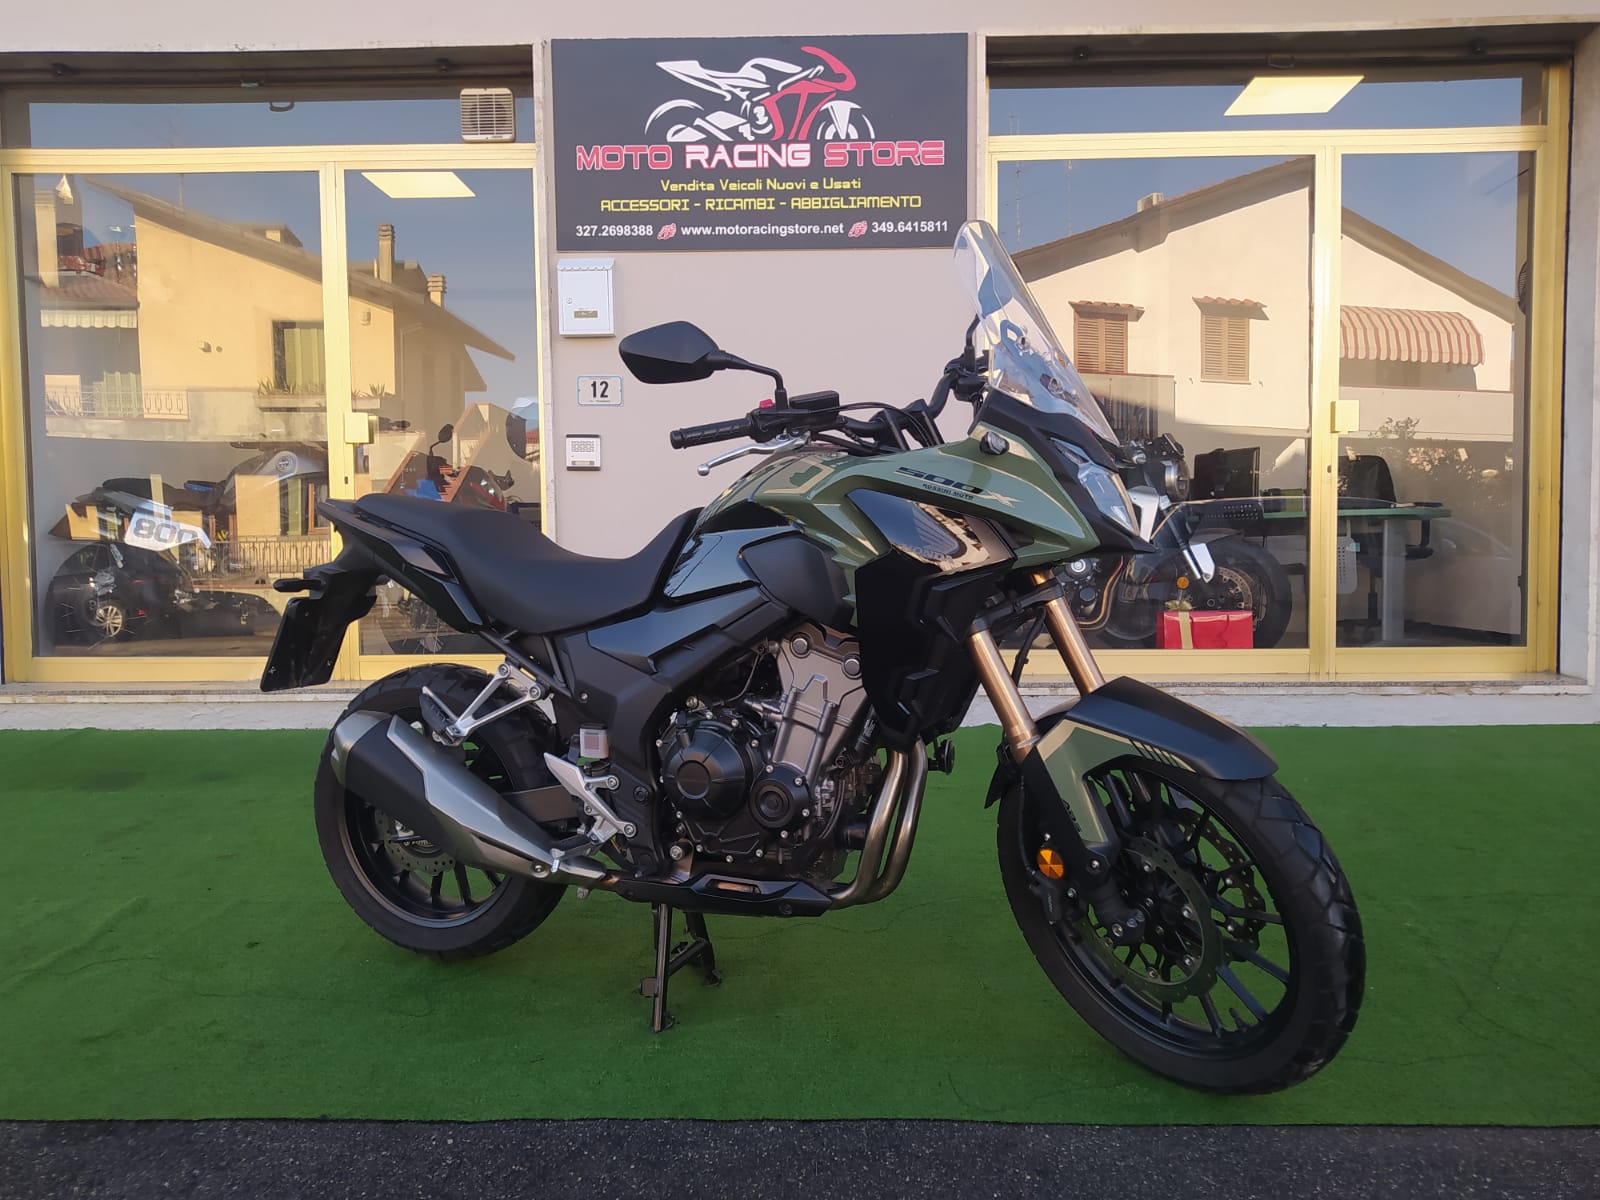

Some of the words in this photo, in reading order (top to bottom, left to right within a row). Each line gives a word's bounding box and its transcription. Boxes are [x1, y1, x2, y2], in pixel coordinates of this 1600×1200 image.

[576, 145, 673, 171] MOTO
[685, 142, 811, 169] RACING
[824, 140, 945, 167] STORE
[660, 179, 715, 192] Vendita
[719, 178, 763, 191] Veicoli
[767, 178, 806, 190] Nuovi
[810, 182, 819, 190] e
[823, 177, 862, 190] Usati
[600, 198, 690, 212] ACCESSORI
[705, 197, 776, 211] RICAMBI
[791, 195, 922, 210] ABBIGLIAMENTO
[575, 224, 654, 237] 327.2698388
[681, 222, 845, 237] www.motoracingstore.net
[871, 221, 949, 234] 349.6415811
[591, 380, 609, 398] 12
